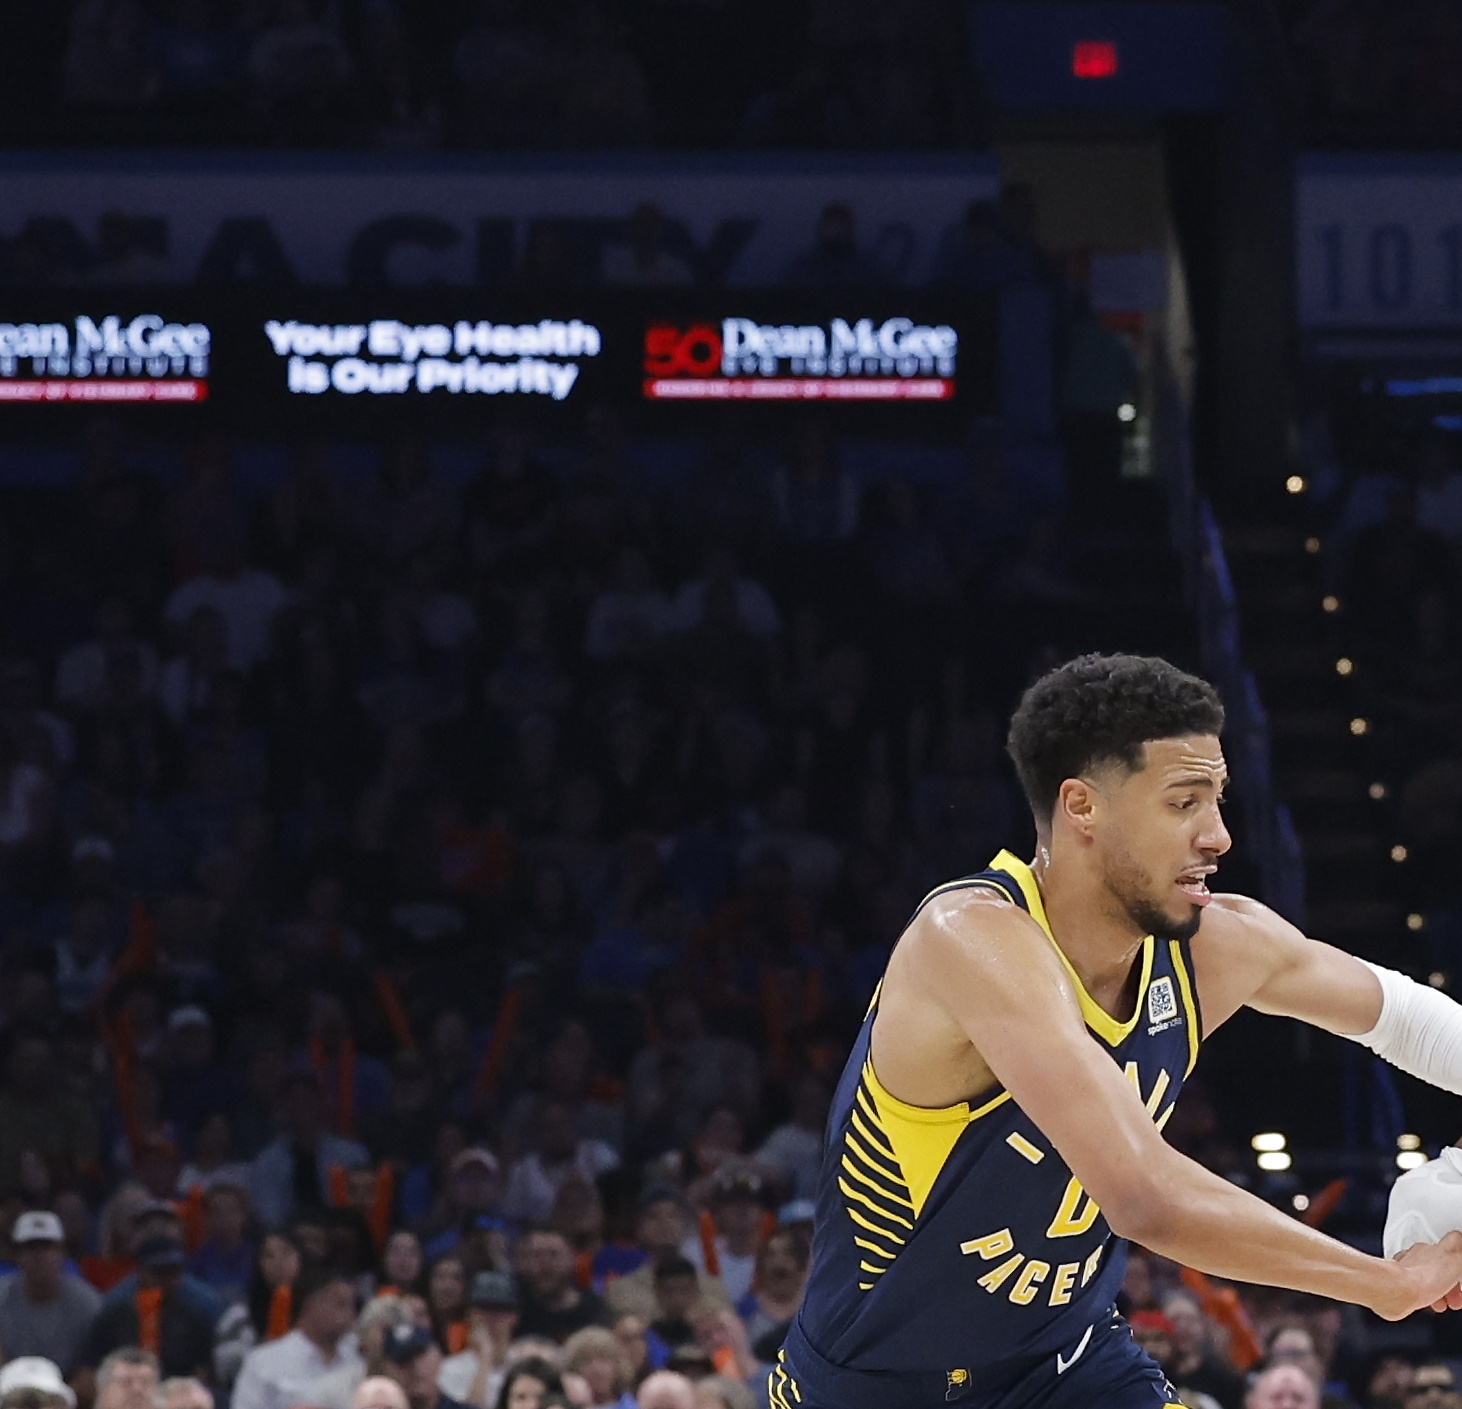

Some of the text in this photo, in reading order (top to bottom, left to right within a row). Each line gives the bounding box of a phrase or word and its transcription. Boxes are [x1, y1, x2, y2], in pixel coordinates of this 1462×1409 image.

[0, 322, 70, 357] ean
[264, 319, 601, 362] Your Eye Health
[722, 317, 827, 359] Dean
[288, 355, 580, 401] Is Our Priority
[960, 1228, 1113, 1307] PACER
